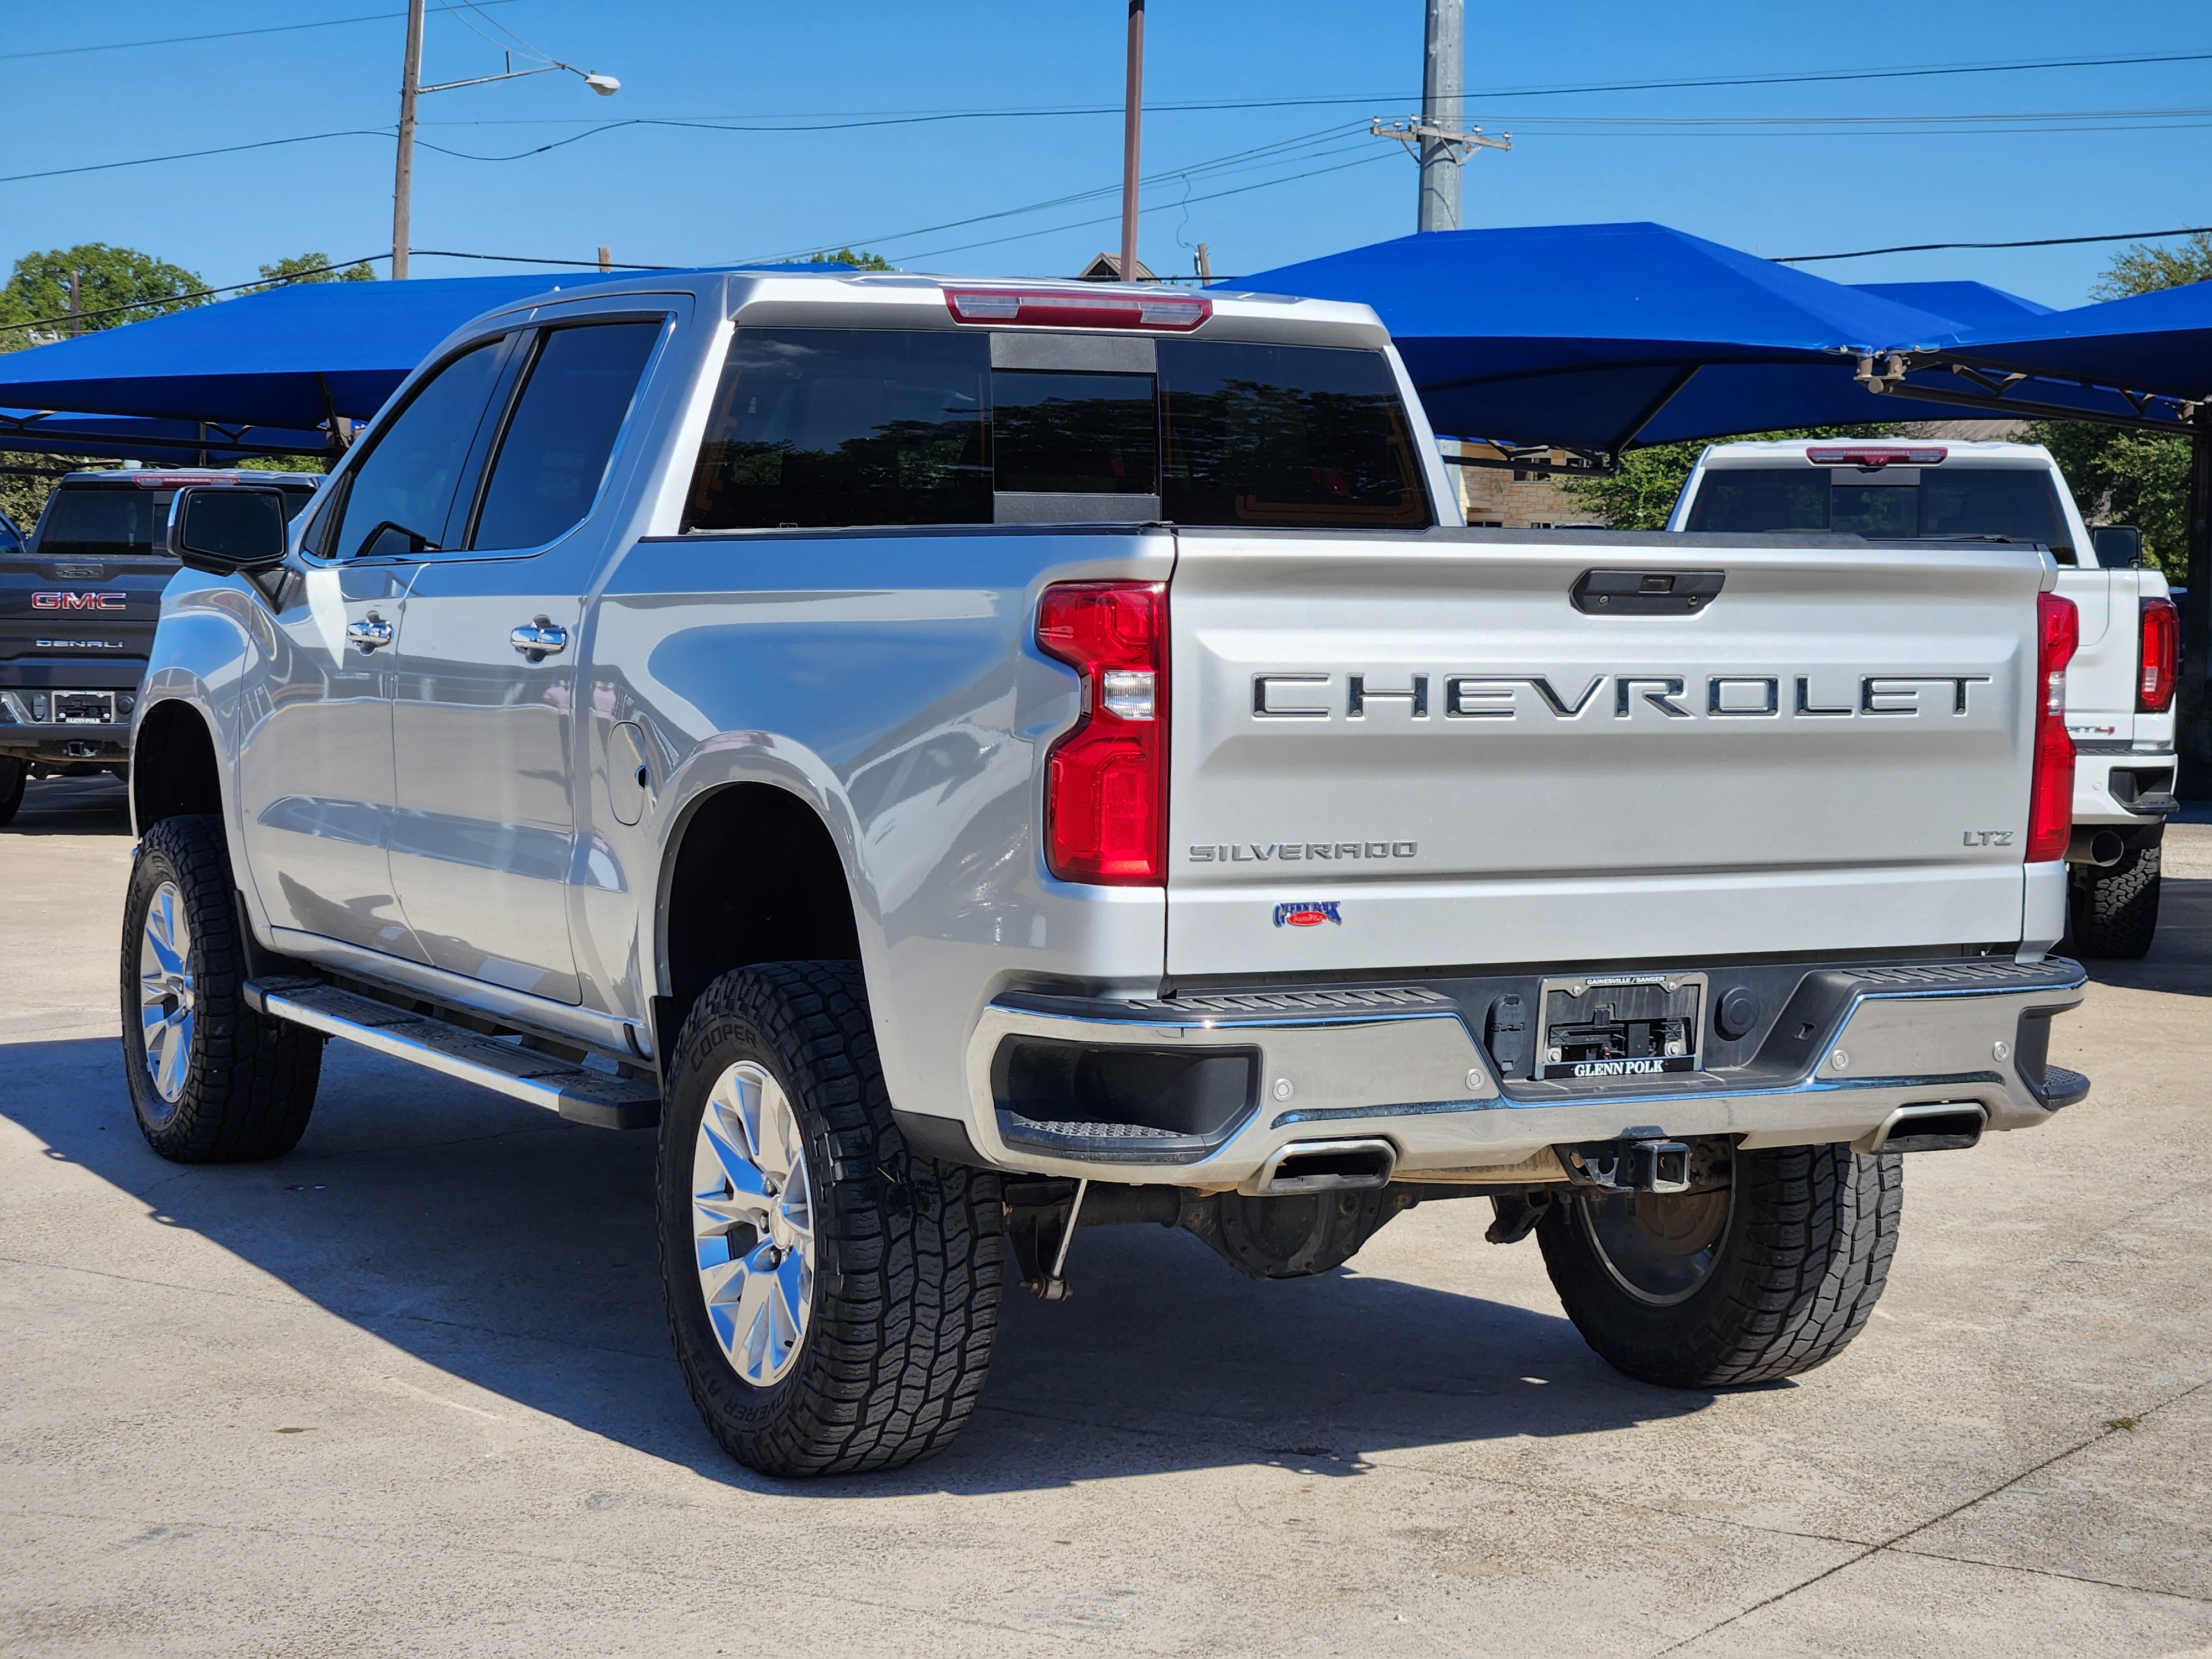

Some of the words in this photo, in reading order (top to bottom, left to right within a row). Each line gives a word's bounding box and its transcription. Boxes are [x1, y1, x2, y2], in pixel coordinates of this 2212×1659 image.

[32, 592, 127, 611] GMC
[35, 640, 123, 648] DENALI
[1253, 672, 1993, 721] CHEVROLET
[1963, 831, 2014, 847] LTZ
[1189, 840, 1418, 863] SILVERADO
[691, 1023, 758, 1073] COOPER
[1574, 1062, 1625, 1077] GLENN
[1625, 1060, 1665, 1074] POLK
